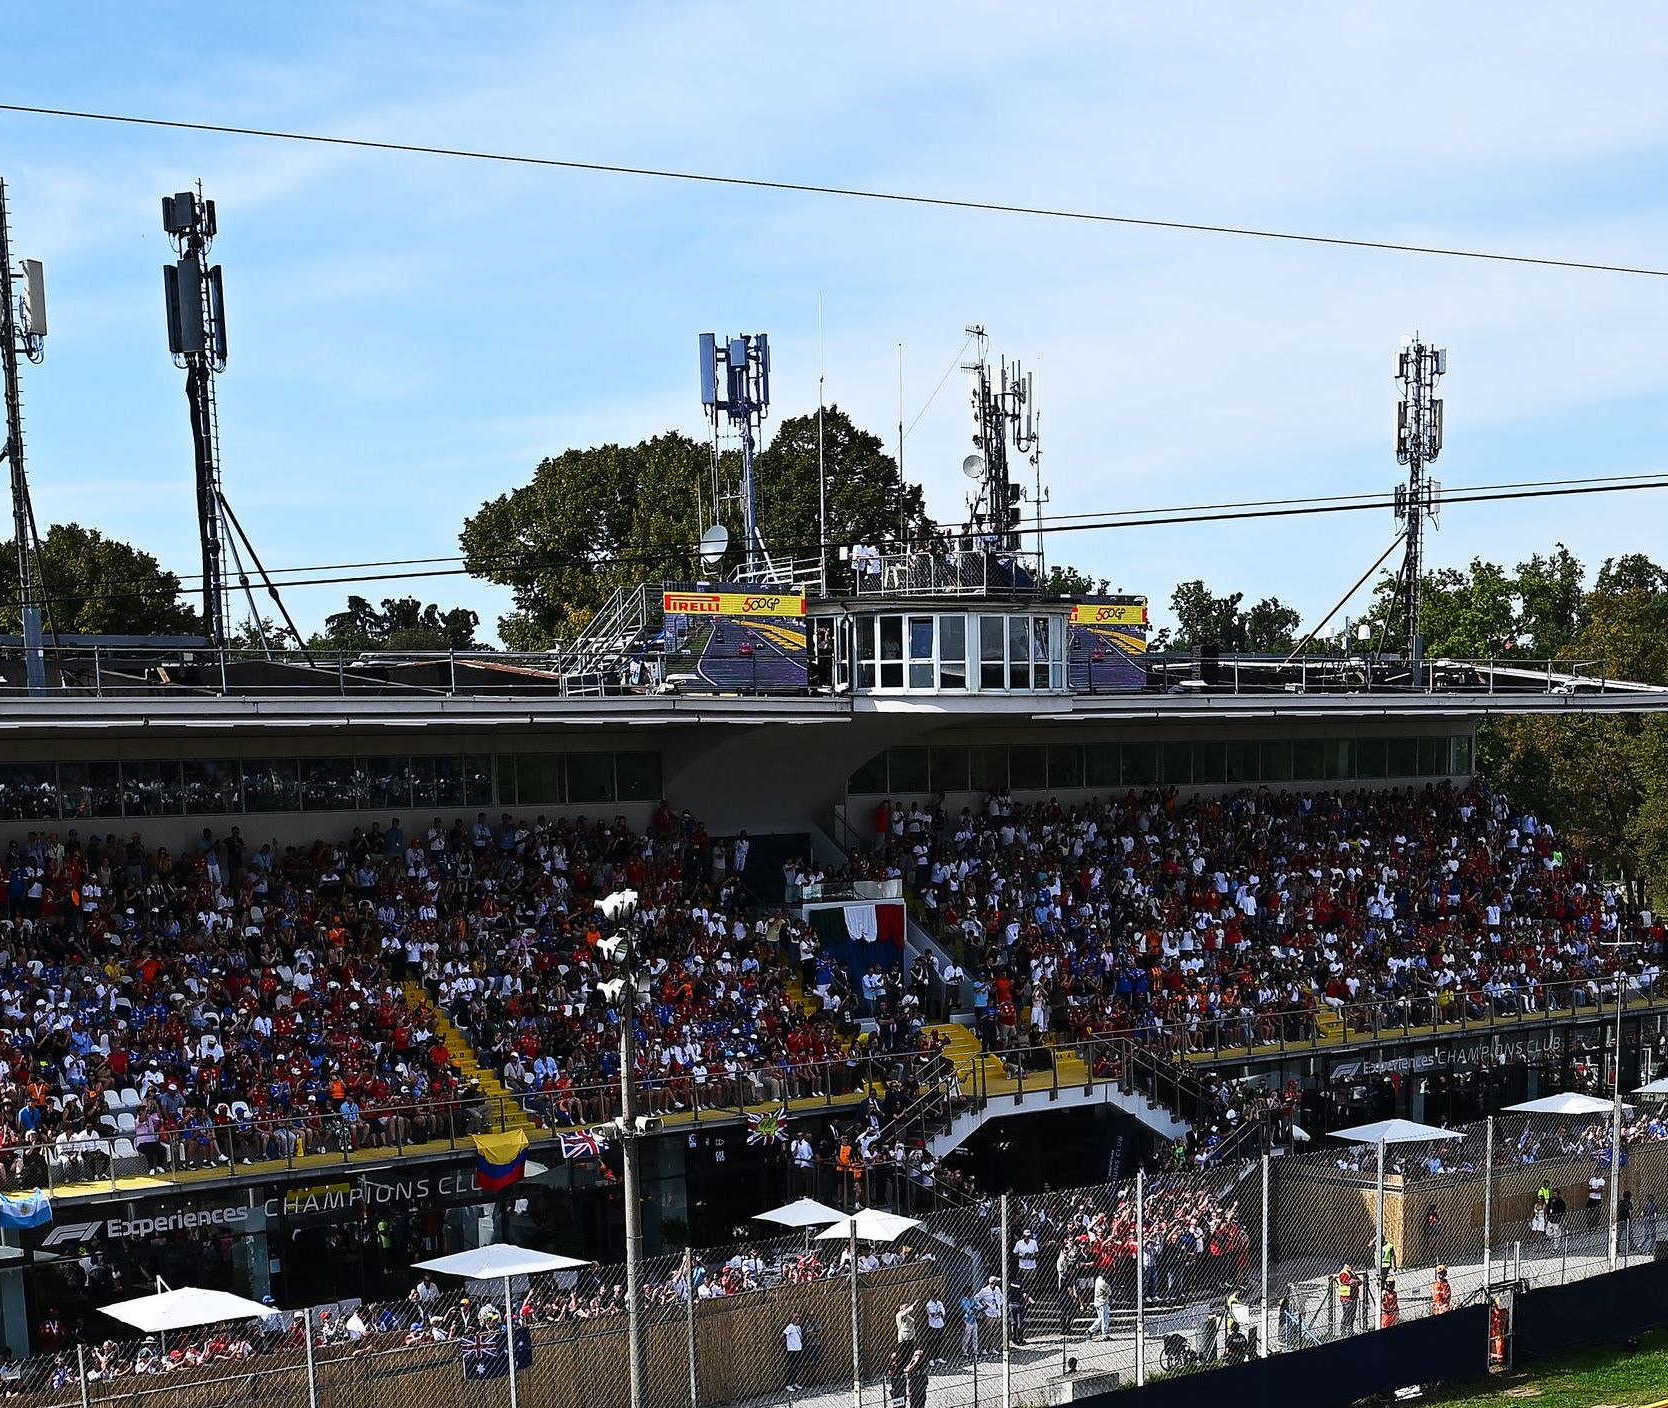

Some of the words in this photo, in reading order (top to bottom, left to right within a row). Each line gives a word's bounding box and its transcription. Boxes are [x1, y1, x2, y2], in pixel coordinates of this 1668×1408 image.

[665, 595, 720, 612] PIRELLI
[107, 1204, 248, 1239] Experiences
[264, 1177, 430, 1217] CHAMPIONS
[438, 1174, 482, 1196] CLU
